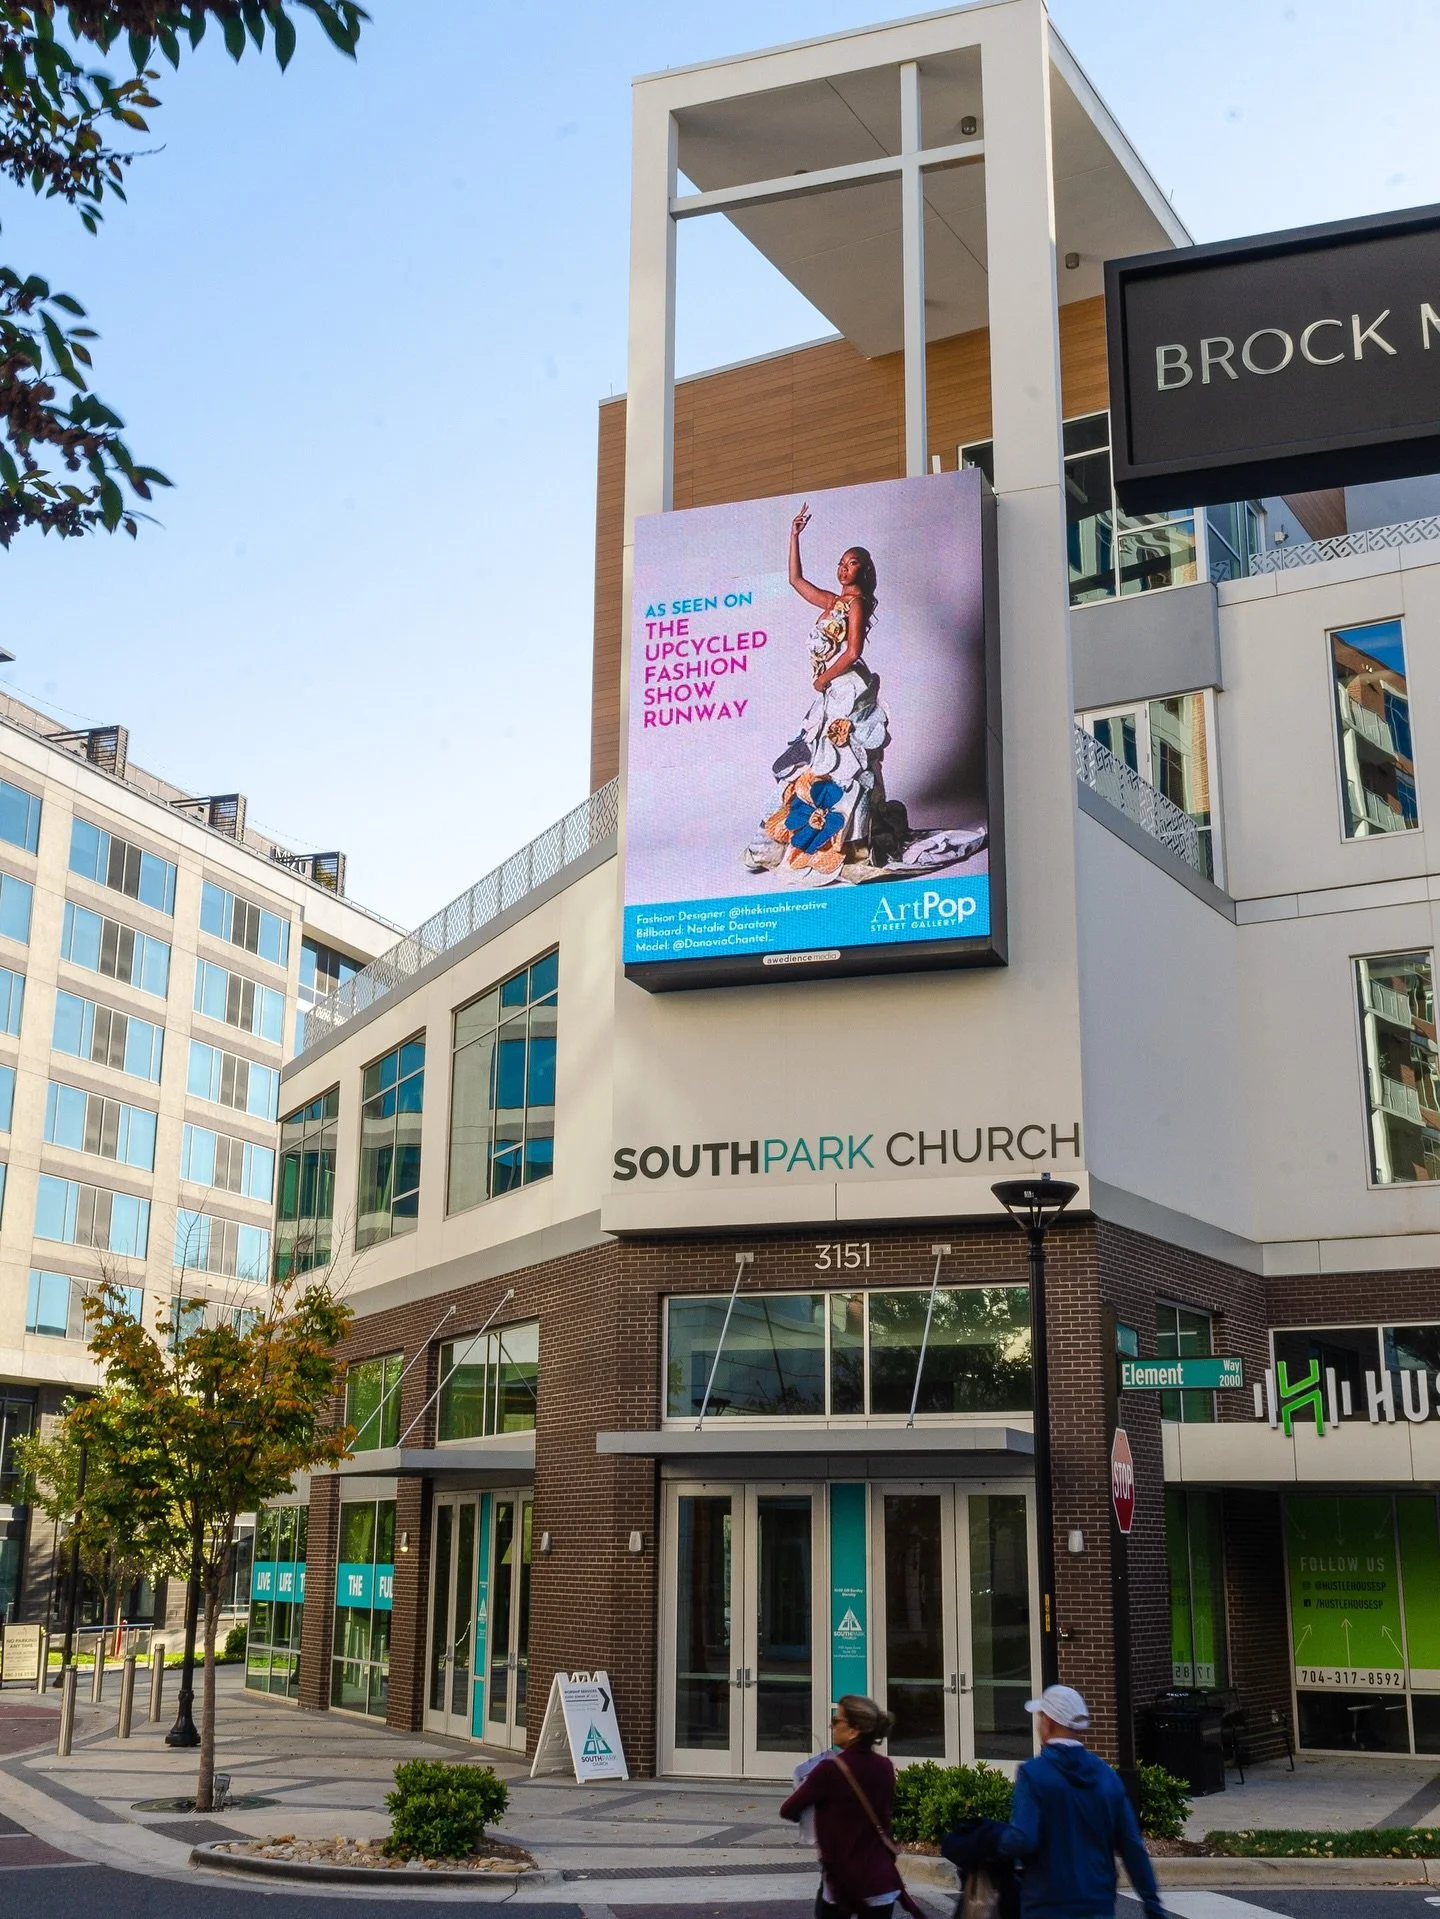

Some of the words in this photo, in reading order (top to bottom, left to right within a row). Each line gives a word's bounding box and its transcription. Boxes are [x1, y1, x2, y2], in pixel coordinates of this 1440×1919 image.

[1155, 309, 1397, 391] BROCK
[645, 604, 666, 618] AS
[672, 596, 717, 615] SEEN
[723, 592, 752, 607] ON
[645, 618, 689, 640] THE
[645, 631, 767, 661] UPCYCLED
[645, 655, 747, 684] FASHION
[643, 680, 716, 706] SHOW
[643, 700, 748, 728] RUNWAY
[636, 912, 675, 924] Fashion
[678, 911, 726, 922] Designer:
[871, 891, 976, 923] ArtPop
[635, 924, 684, 939] Billboard:
[687, 921, 726, 934] Natalie
[728, 920, 778, 931] Daratony
[871, 922, 906, 932] STREET
[911, 919, 956, 929] GALLERY
[635, 940, 670, 952] Model:
[766, 954, 813, 964] awedience
[813, 952, 837, 961] media
[612, 1134, 875, 1182] SOUTHPARK
[886, 1122, 1081, 1167] CHURCH
[814, 1242, 871, 1270] 3151
[1121, 1363, 1184, 1386] Element
[1223, 1359, 1240, 1374] Way
[1219, 1375, 1241, 1387] 2000
[1365, 1369, 1440, 1423] HU
[1113, 1463, 1133, 1500] STOP
[1300, 1557, 1358, 1572] FOLLOW
[1366, 1557, 1385, 1572] US
[257, 1572, 271, 1591] LIVE
[279, 1573, 292, 1592] LIFE
[348, 1575, 363, 1597] THE
[1315, 1581, 1386, 1592] @HUSTLEHOUSESP
[1302, 1670, 1400, 1686] 704-317-8592
